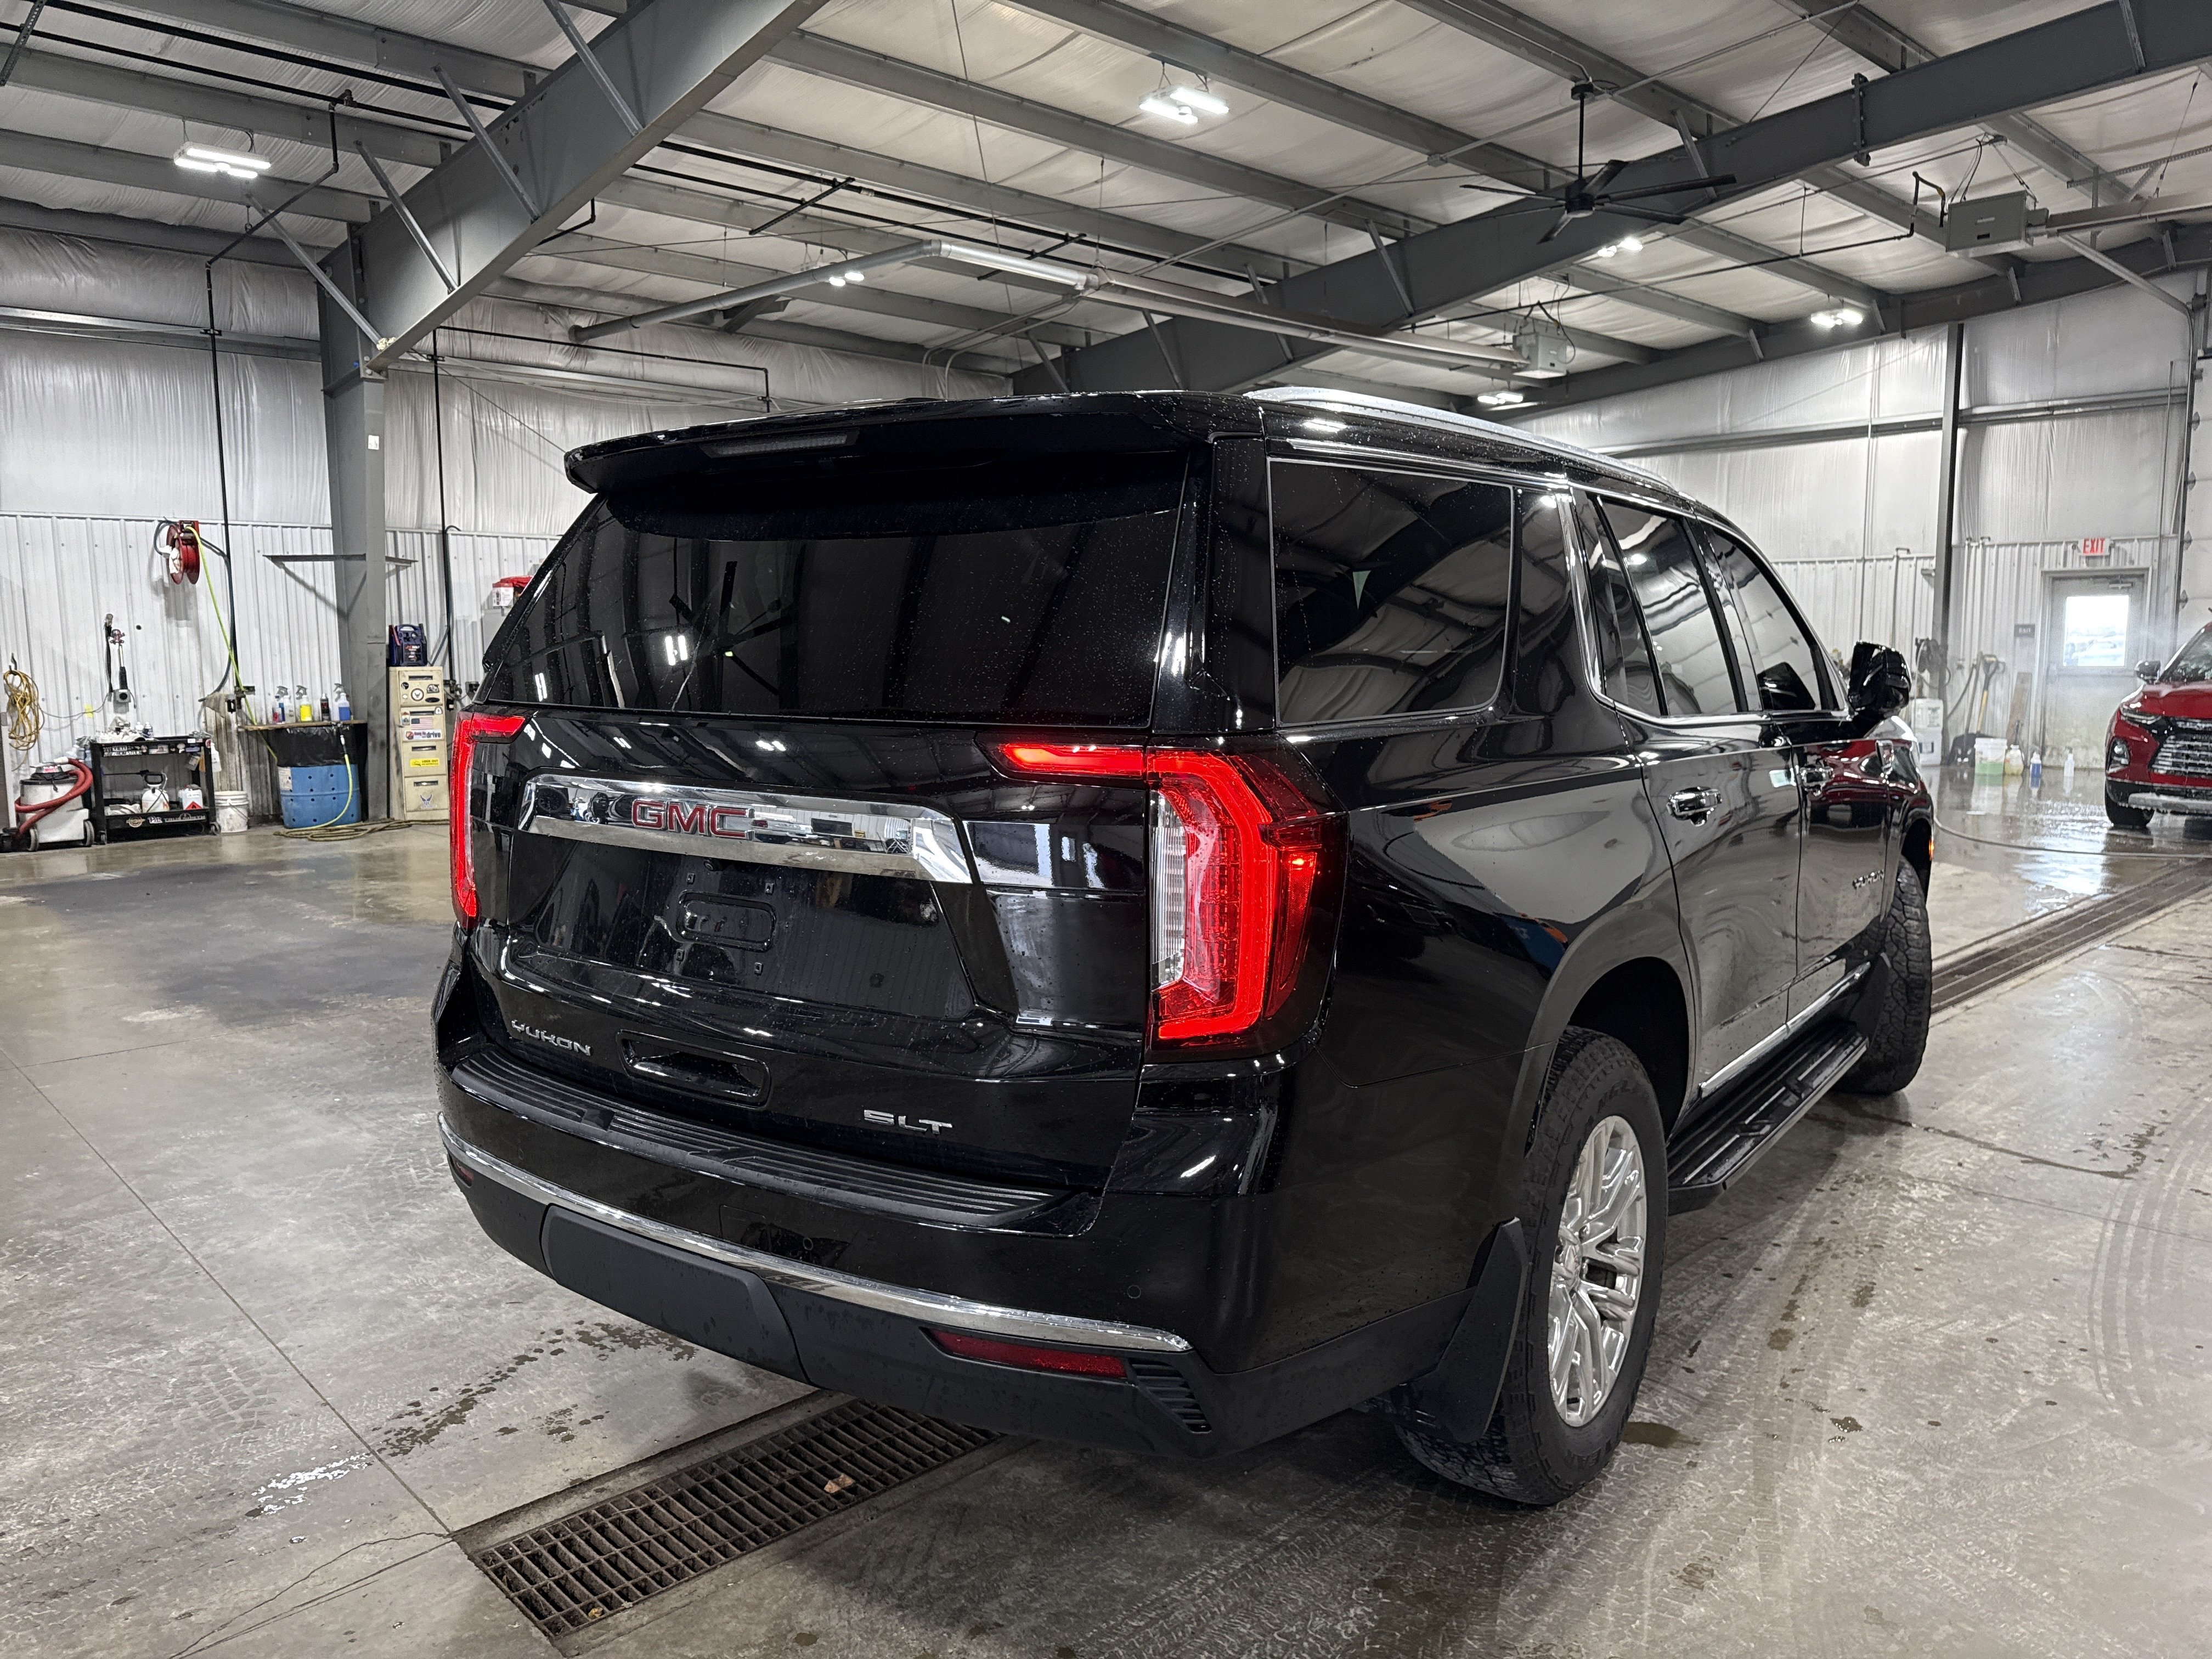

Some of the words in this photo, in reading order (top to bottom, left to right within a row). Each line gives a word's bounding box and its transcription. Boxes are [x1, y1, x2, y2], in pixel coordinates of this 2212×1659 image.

[2083, 538, 2106, 555] EXIT
[631, 799, 755, 840] GMC
[1852, 869, 1885, 889] YUKON
[511, 1019, 591, 1056] YUKON
[864, 1109, 953, 1135] SLT
